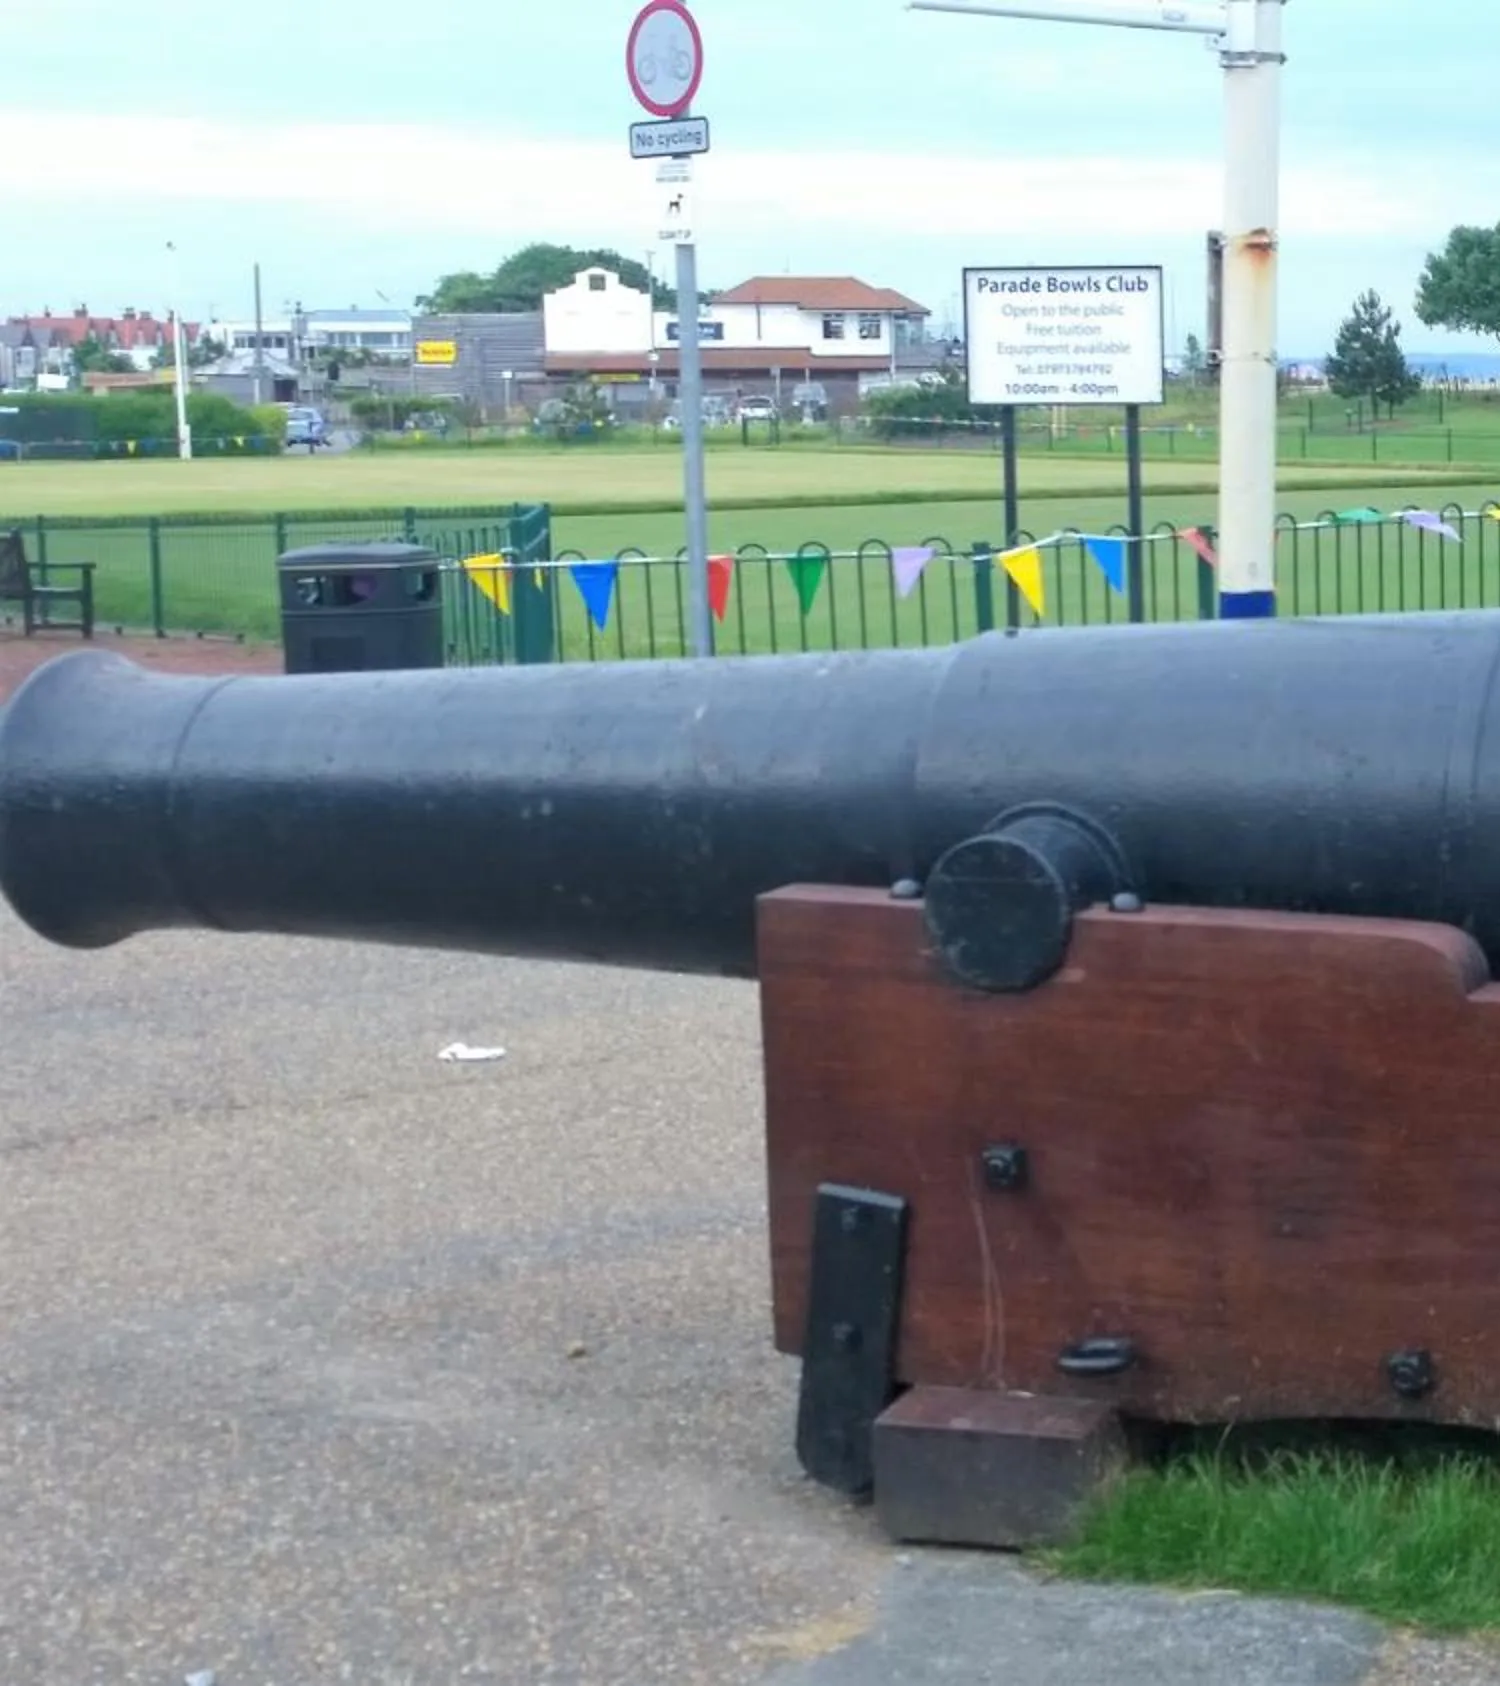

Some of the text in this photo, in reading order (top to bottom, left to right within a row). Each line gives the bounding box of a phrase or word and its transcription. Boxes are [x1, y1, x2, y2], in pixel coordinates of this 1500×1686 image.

[636, 129, 703, 148] No cycling
[977, 274, 1149, 293] Parade Bowls Club
[1001, 303, 1125, 319] Open to the public
[1026, 323, 1102, 337] Free tuition
[996, 340, 1132, 357] Equipment available
[1005, 383, 1060, 395] 10:00am
[1070, 383, 1118, 397] 4:00pm
